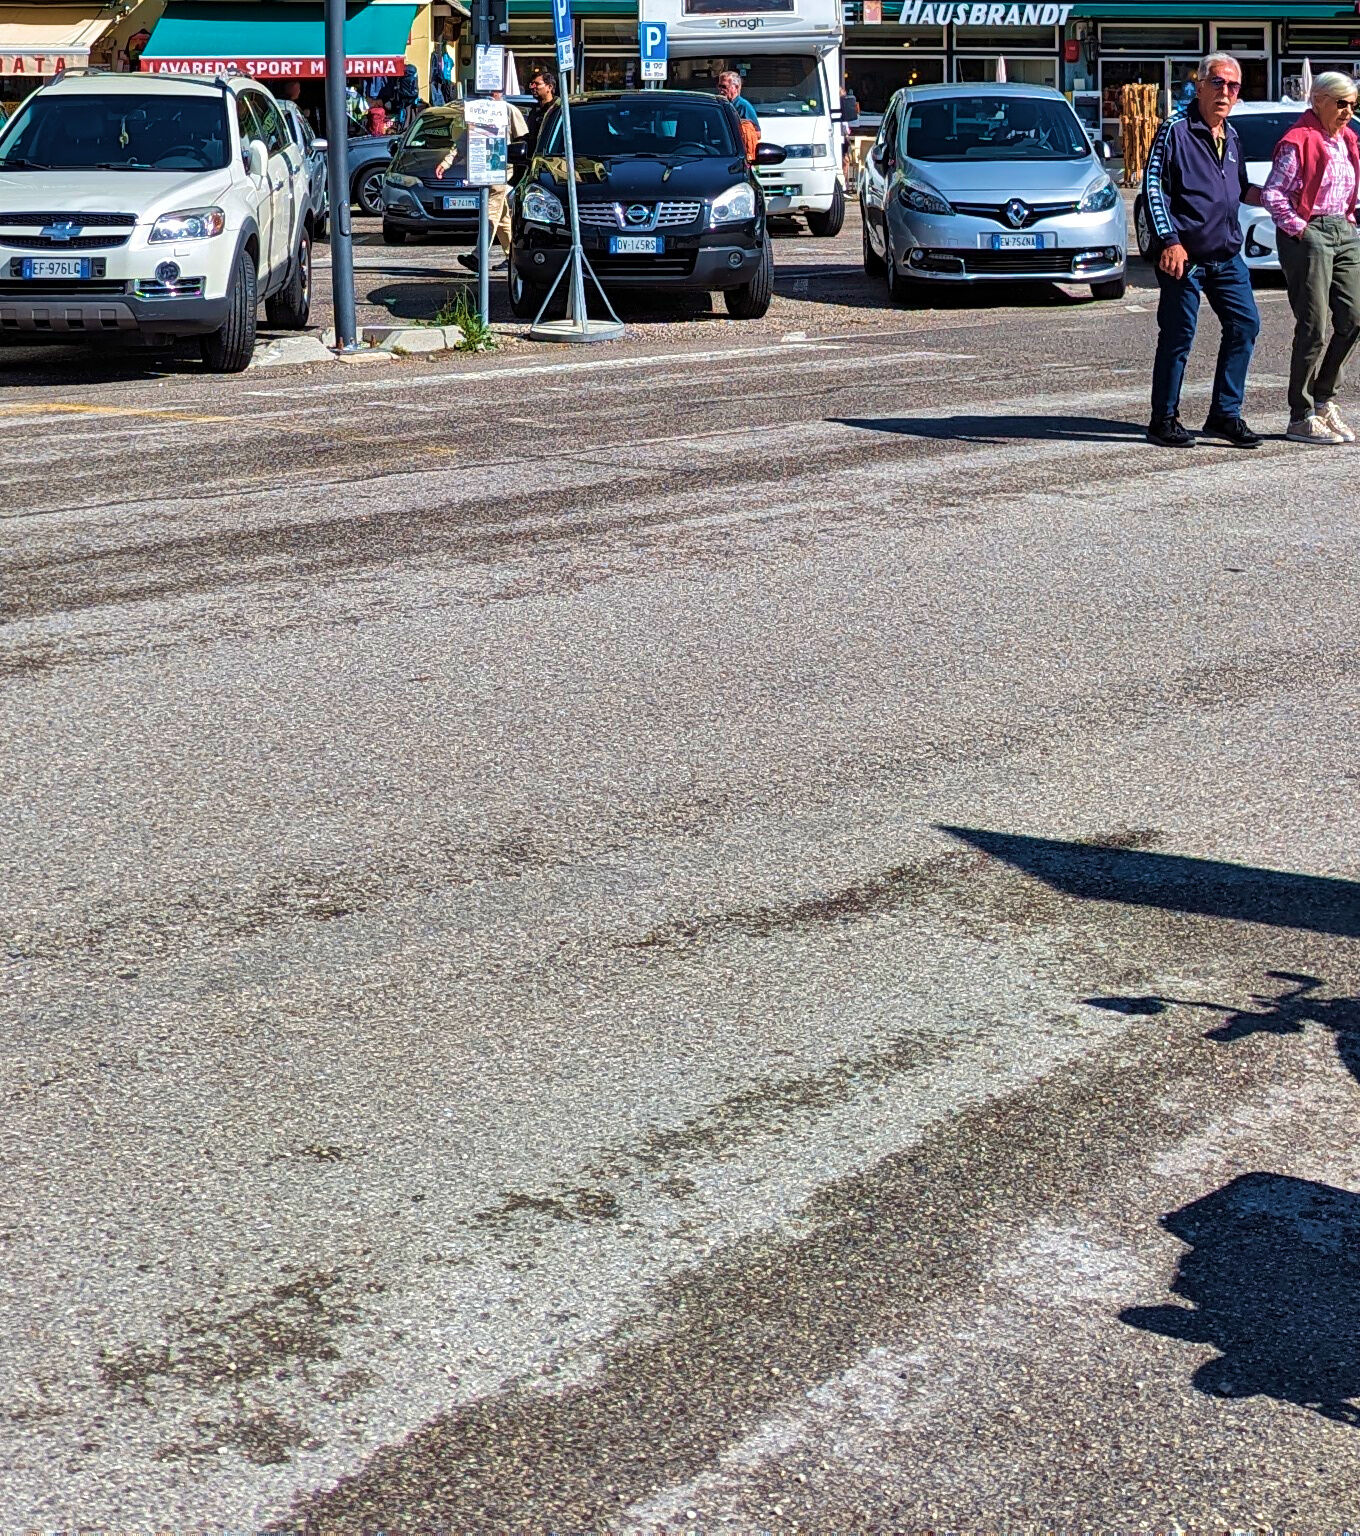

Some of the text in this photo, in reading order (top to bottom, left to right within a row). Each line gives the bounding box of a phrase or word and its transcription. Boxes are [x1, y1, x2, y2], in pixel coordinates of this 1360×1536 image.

[718, 16, 764, 30] elnagh
[899, 0, 1074, 26] HAUSBRANDT
[646, 26, 661, 56] P
[149, 60, 397, 75] LAVAREDO SPORT MURINA
